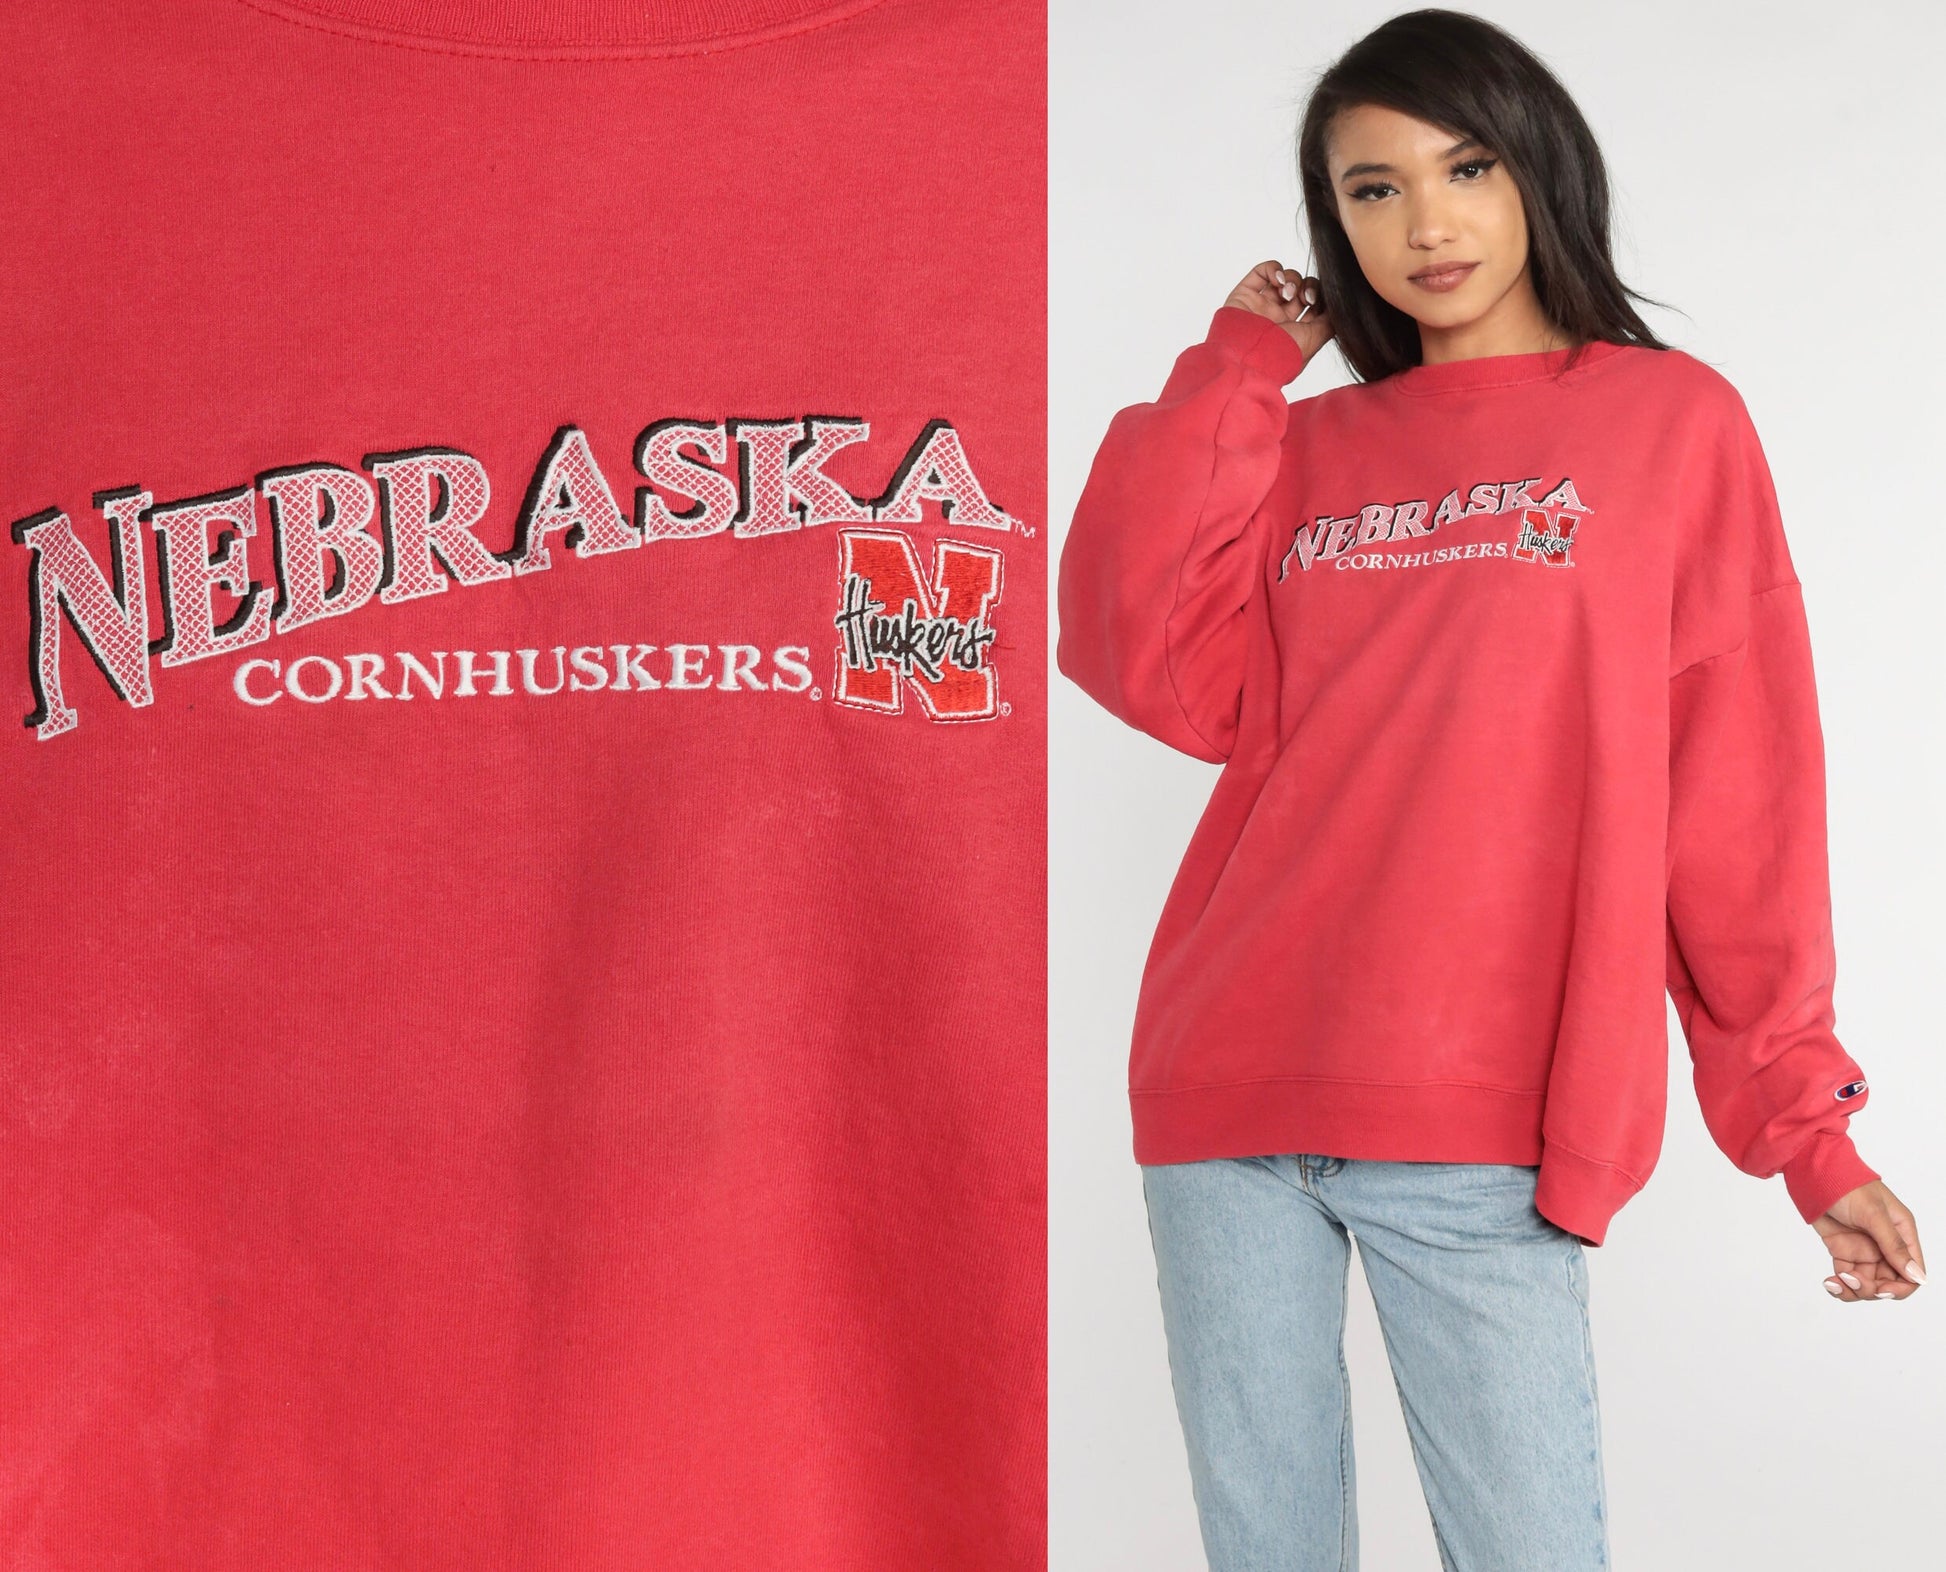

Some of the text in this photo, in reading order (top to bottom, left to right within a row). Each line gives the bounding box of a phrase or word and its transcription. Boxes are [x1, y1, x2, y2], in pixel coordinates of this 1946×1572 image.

[1278, 477, 1587, 584] NEBRASKA
[1335, 542, 1508, 572] CORNHUSKERS
[1518, 522, 1575, 555] Huskers
[11, 414, 1012, 742] NEBRASKA
[834, 573, 996, 684] Huskers
[232, 644, 813, 707] CORNHUSKERS
